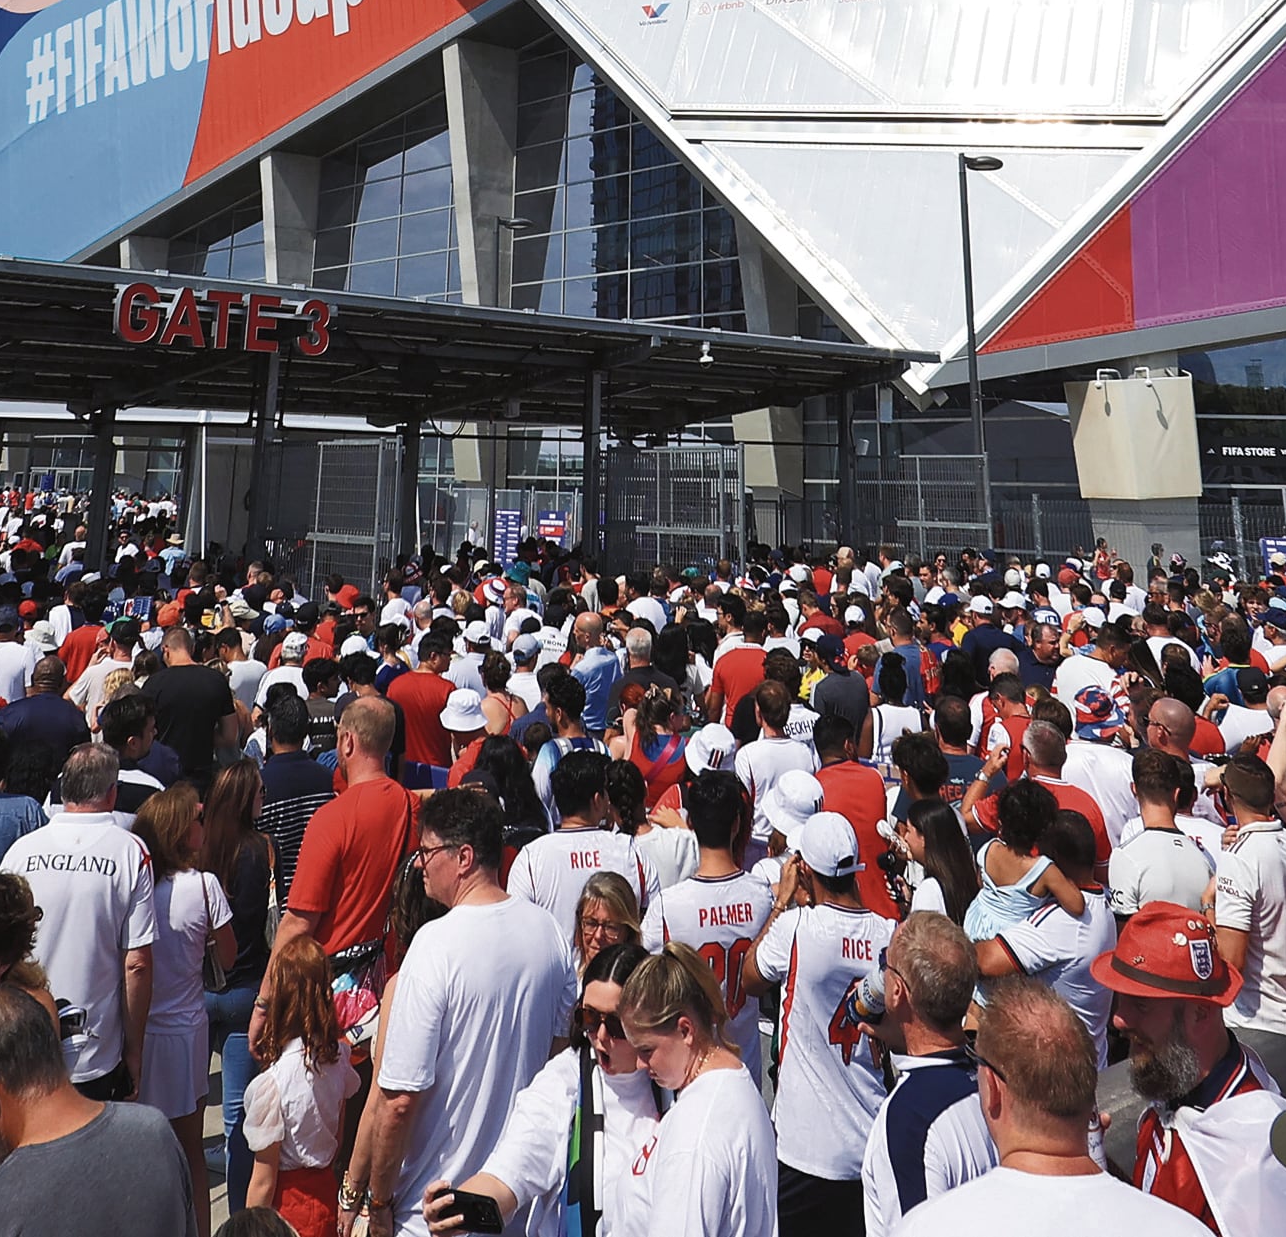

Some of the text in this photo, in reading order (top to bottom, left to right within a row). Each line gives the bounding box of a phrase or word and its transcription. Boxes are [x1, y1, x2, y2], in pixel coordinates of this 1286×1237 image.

[116, 282, 332, 356] GATE 3
[1221, 446, 1244, 456] FIFA
[1244, 446, 1276, 457] STORE
[25, 854, 117, 877] ENGLAND
[570, 850, 601, 869] RICE
[698, 902, 754, 928] PALMER
[842, 937, 874, 961] RICE
